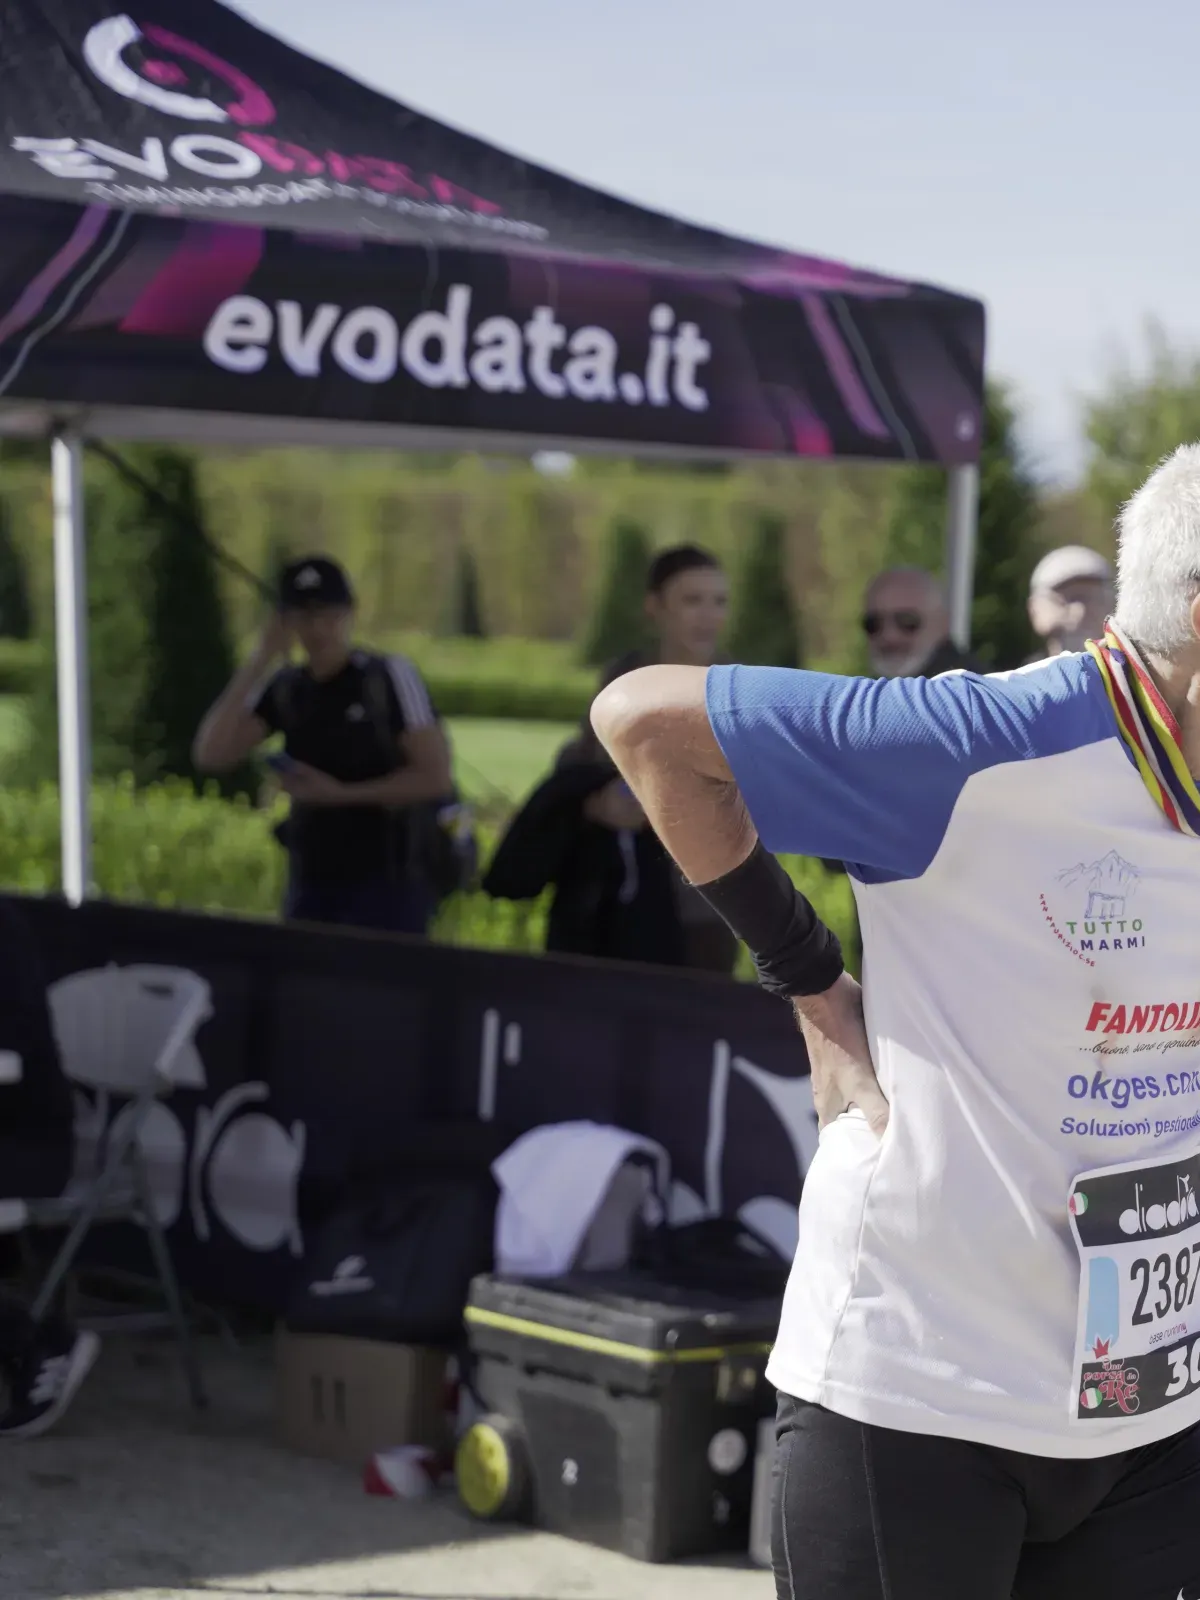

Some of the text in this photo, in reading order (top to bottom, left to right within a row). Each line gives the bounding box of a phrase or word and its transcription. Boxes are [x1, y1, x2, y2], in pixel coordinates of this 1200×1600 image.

[203, 284, 711, 412] evodata.it
[1039, 893, 1048, 912] SAN
[1066, 919, 1143, 934] TUTTO
[1080, 936, 1145, 951] MARMI
[1060, 1117, 1151, 1137] Soluzioni
[1118, 1174, 1200, 1235] diadora
[1098, 1379, 1139, 1414] Re
